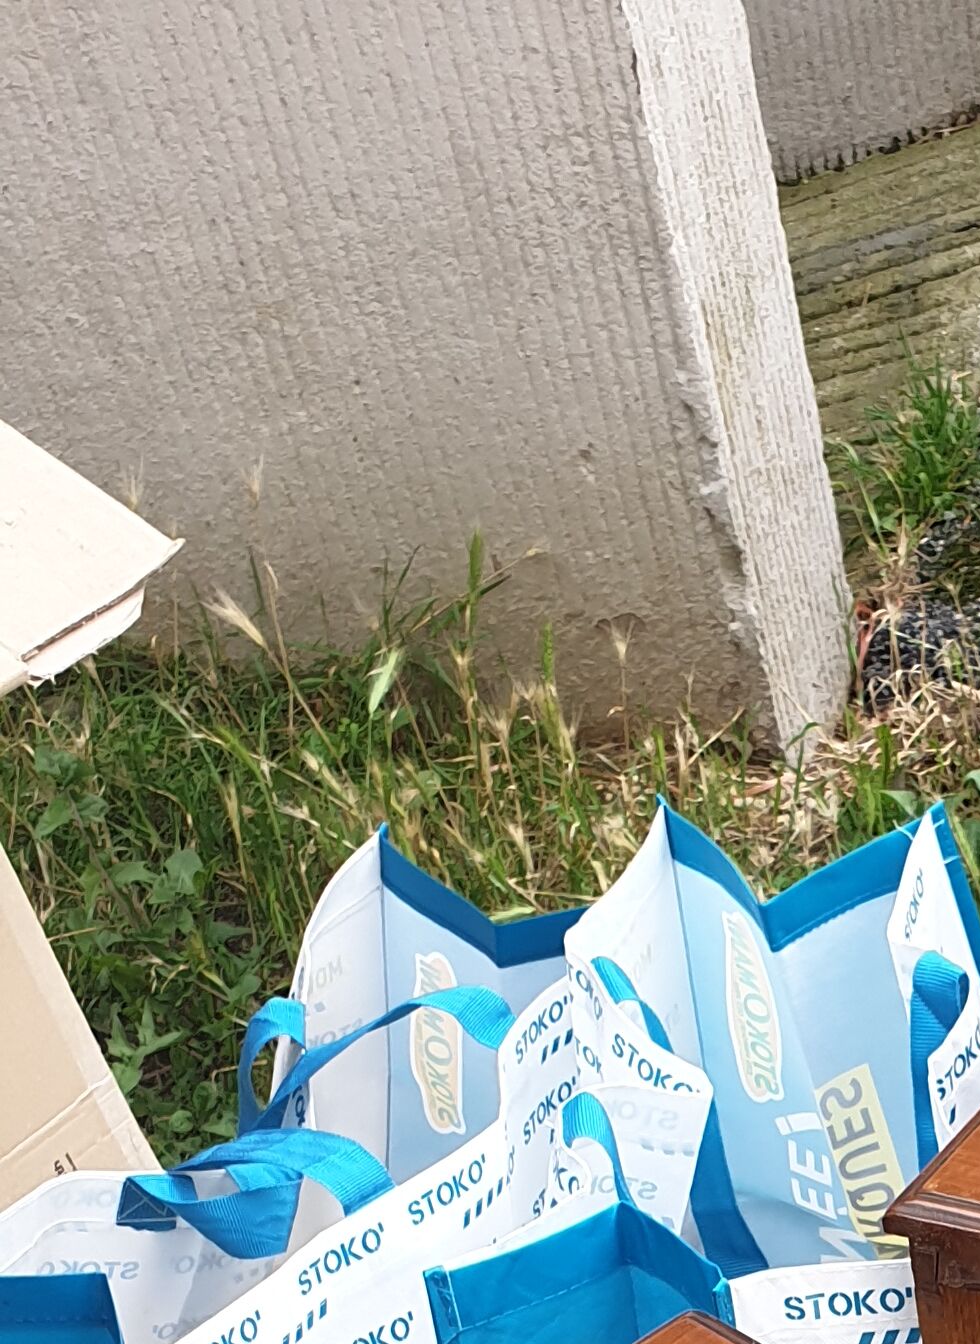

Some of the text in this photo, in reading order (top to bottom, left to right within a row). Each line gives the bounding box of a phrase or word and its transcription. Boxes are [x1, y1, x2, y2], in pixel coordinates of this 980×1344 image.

[515, 995, 568, 1064] STOKO'
[523, 1076, 576, 1145] STOKO'
[408, 1154, 486, 1226] STOKO'
[298, 1222, 385, 1296] STOKO'
[784, 1287, 912, 1320] STOKO'
